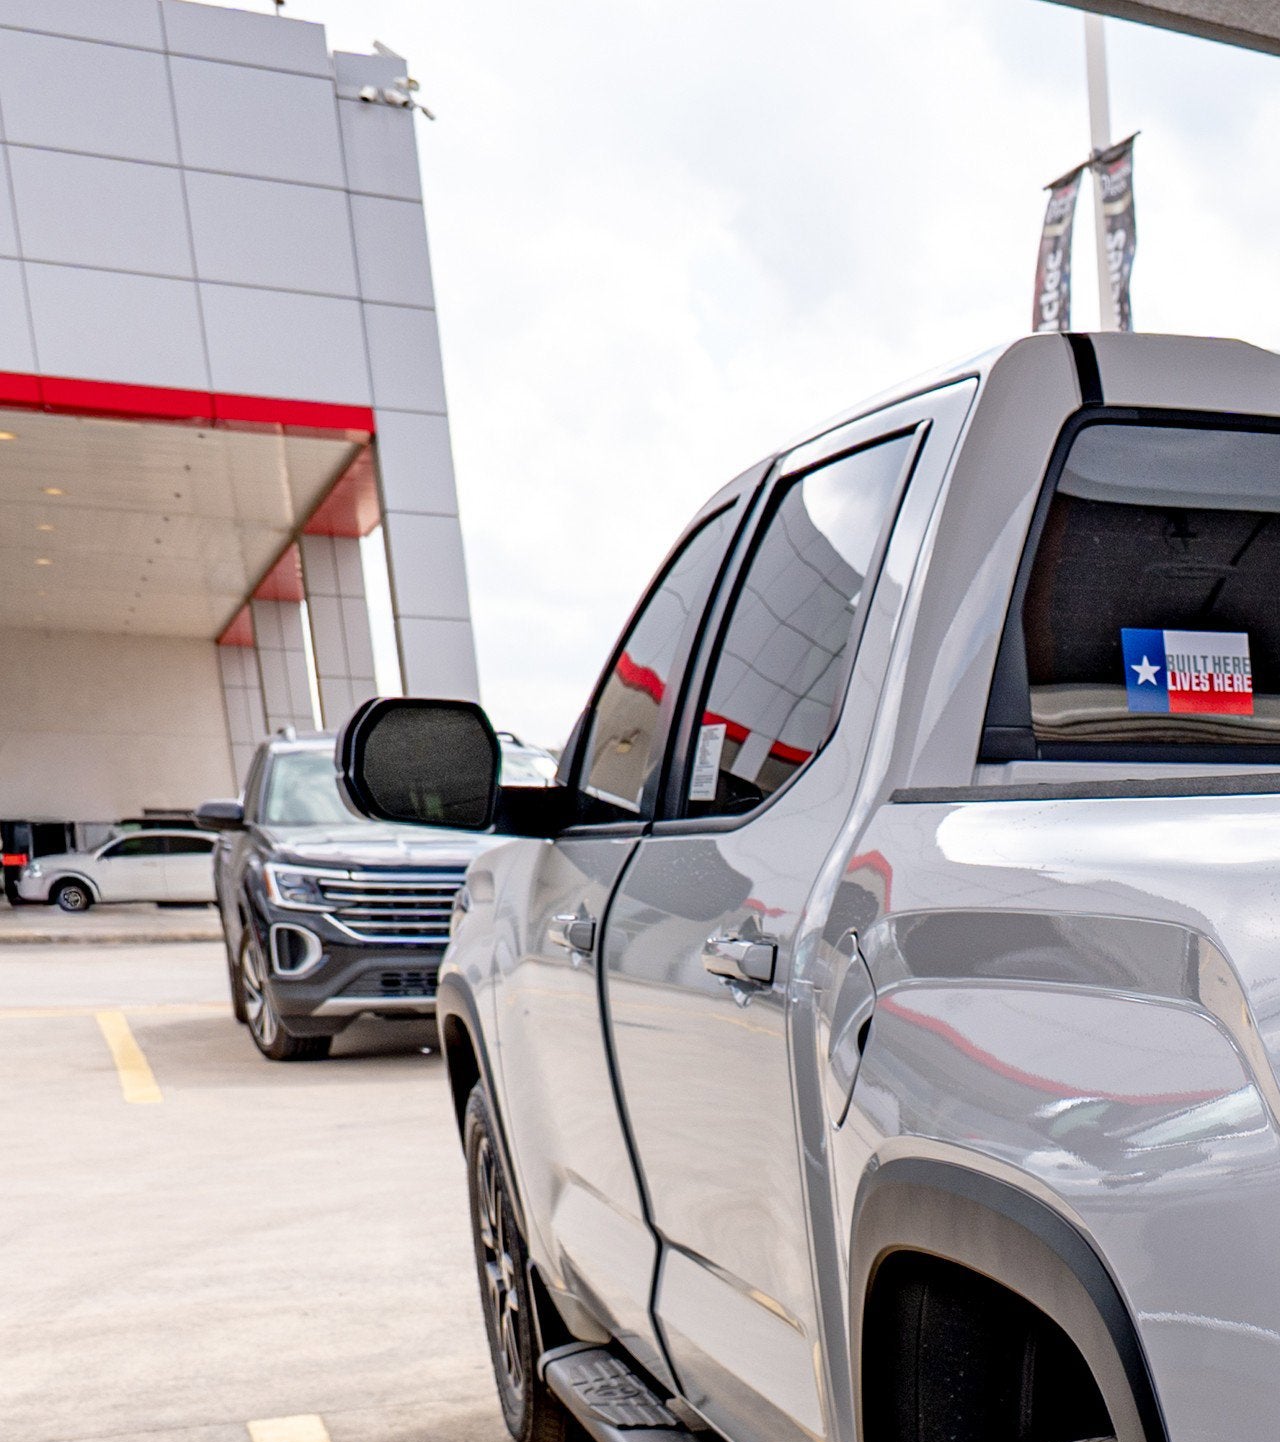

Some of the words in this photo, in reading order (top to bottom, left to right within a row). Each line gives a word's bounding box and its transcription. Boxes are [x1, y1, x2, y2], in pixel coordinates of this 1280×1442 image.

[1166, 654, 1209, 674] BUILT
[1213, 656, 1251, 675] HERE
[1167, 672, 1209, 692] LIVES
[1214, 674, 1253, 693] HERE
